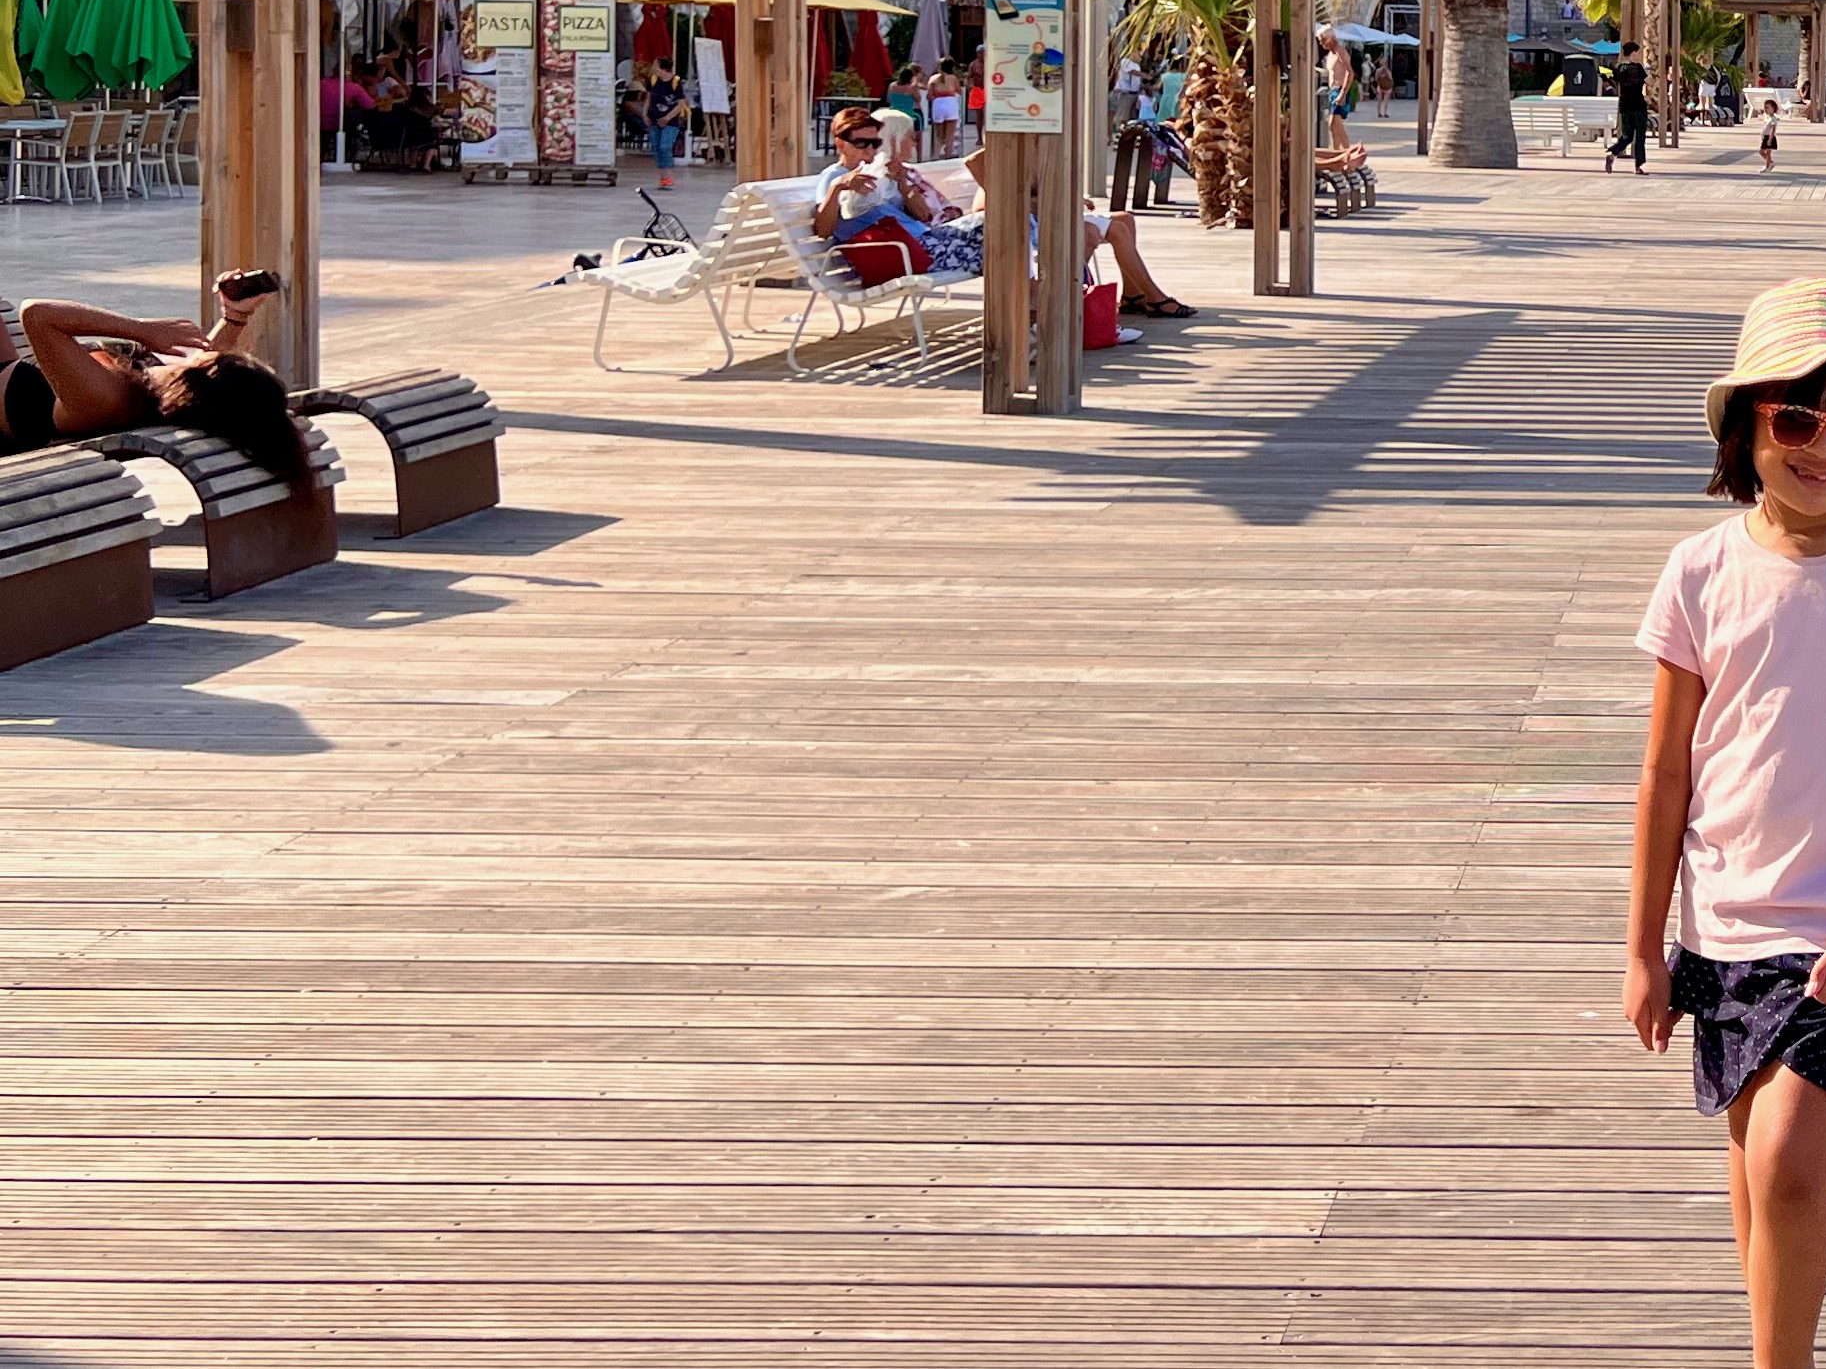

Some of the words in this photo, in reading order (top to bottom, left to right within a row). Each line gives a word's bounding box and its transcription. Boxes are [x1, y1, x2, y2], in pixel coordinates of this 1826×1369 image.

[479, 16, 531, 31] PASTA
[563, 16, 606, 30] PIZZA
[995, 74, 1002, 83] 3
